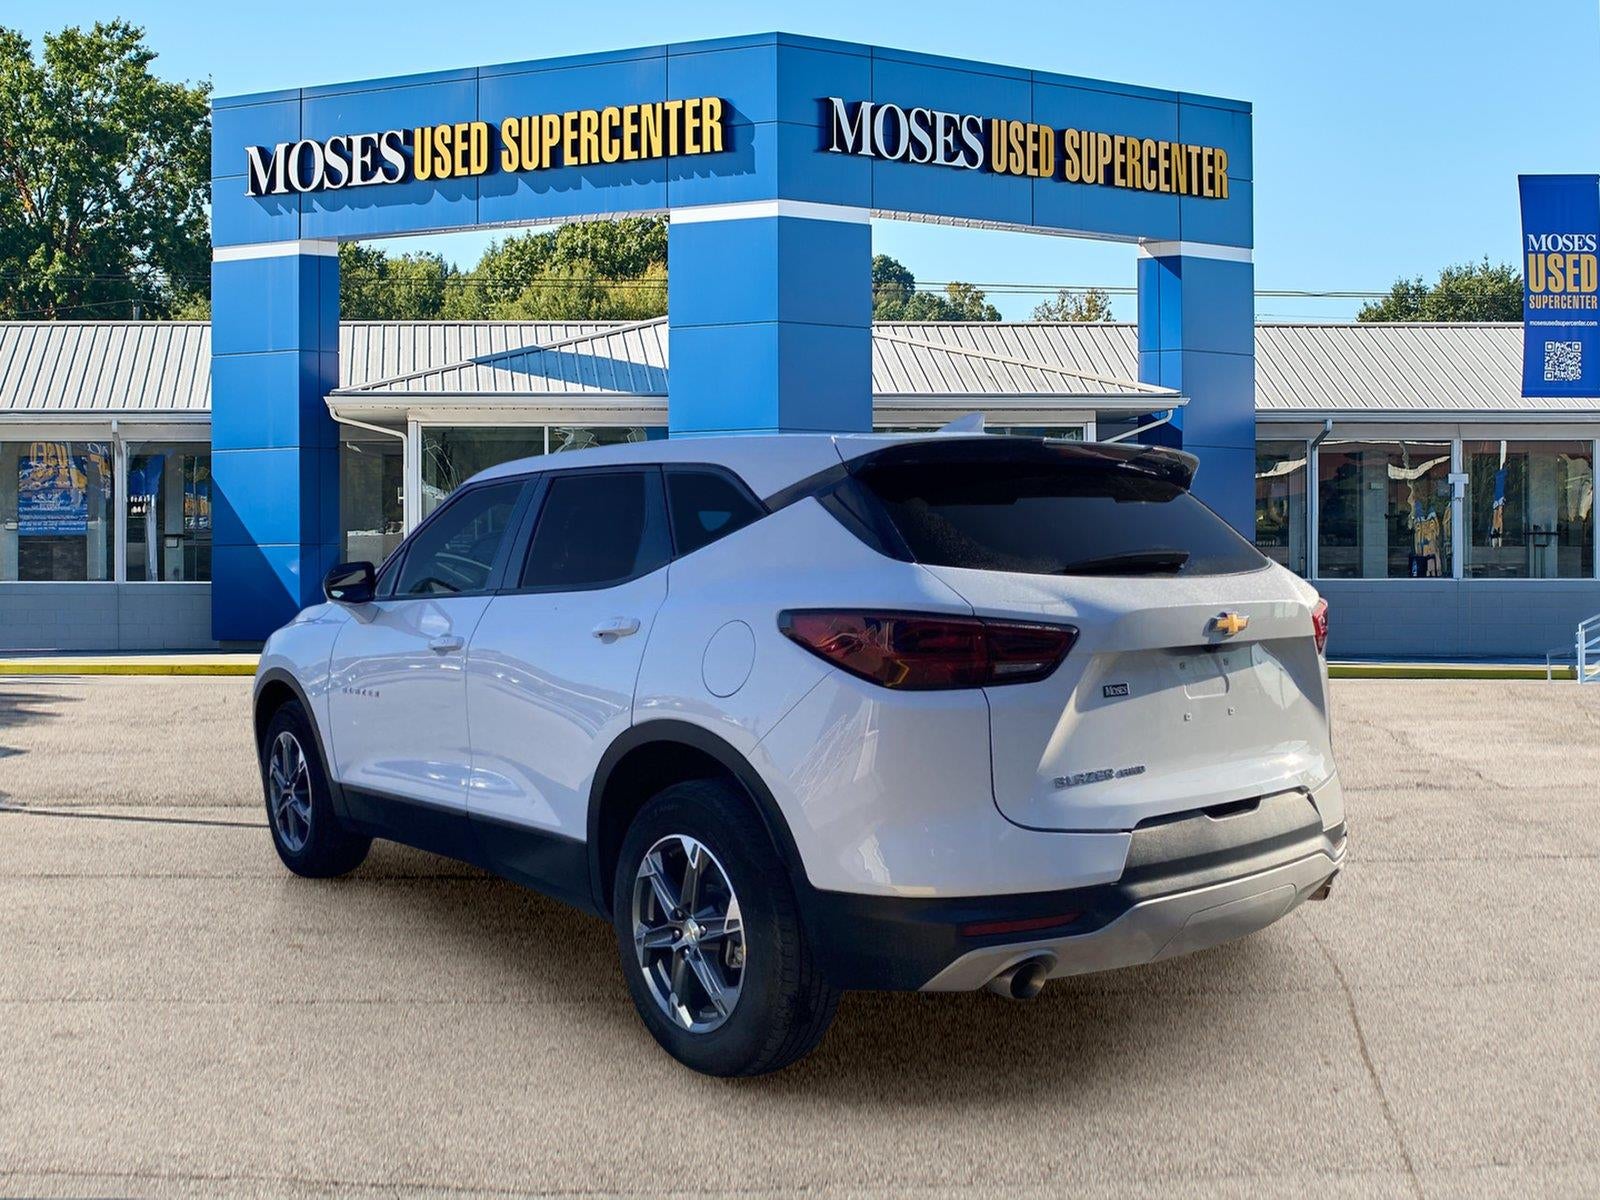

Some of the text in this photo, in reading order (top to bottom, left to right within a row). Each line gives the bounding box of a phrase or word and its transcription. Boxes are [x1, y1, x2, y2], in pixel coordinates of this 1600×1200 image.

[244, 96, 724, 198] MOSES USED SUPERCENTER
[828, 97, 1230, 199] MOSES USED SUPERCENTER
[1527, 234, 1597, 251] MOSES
[1528, 253, 1598, 293] USED
[1529, 295, 1598, 309] SUPERCENTER
